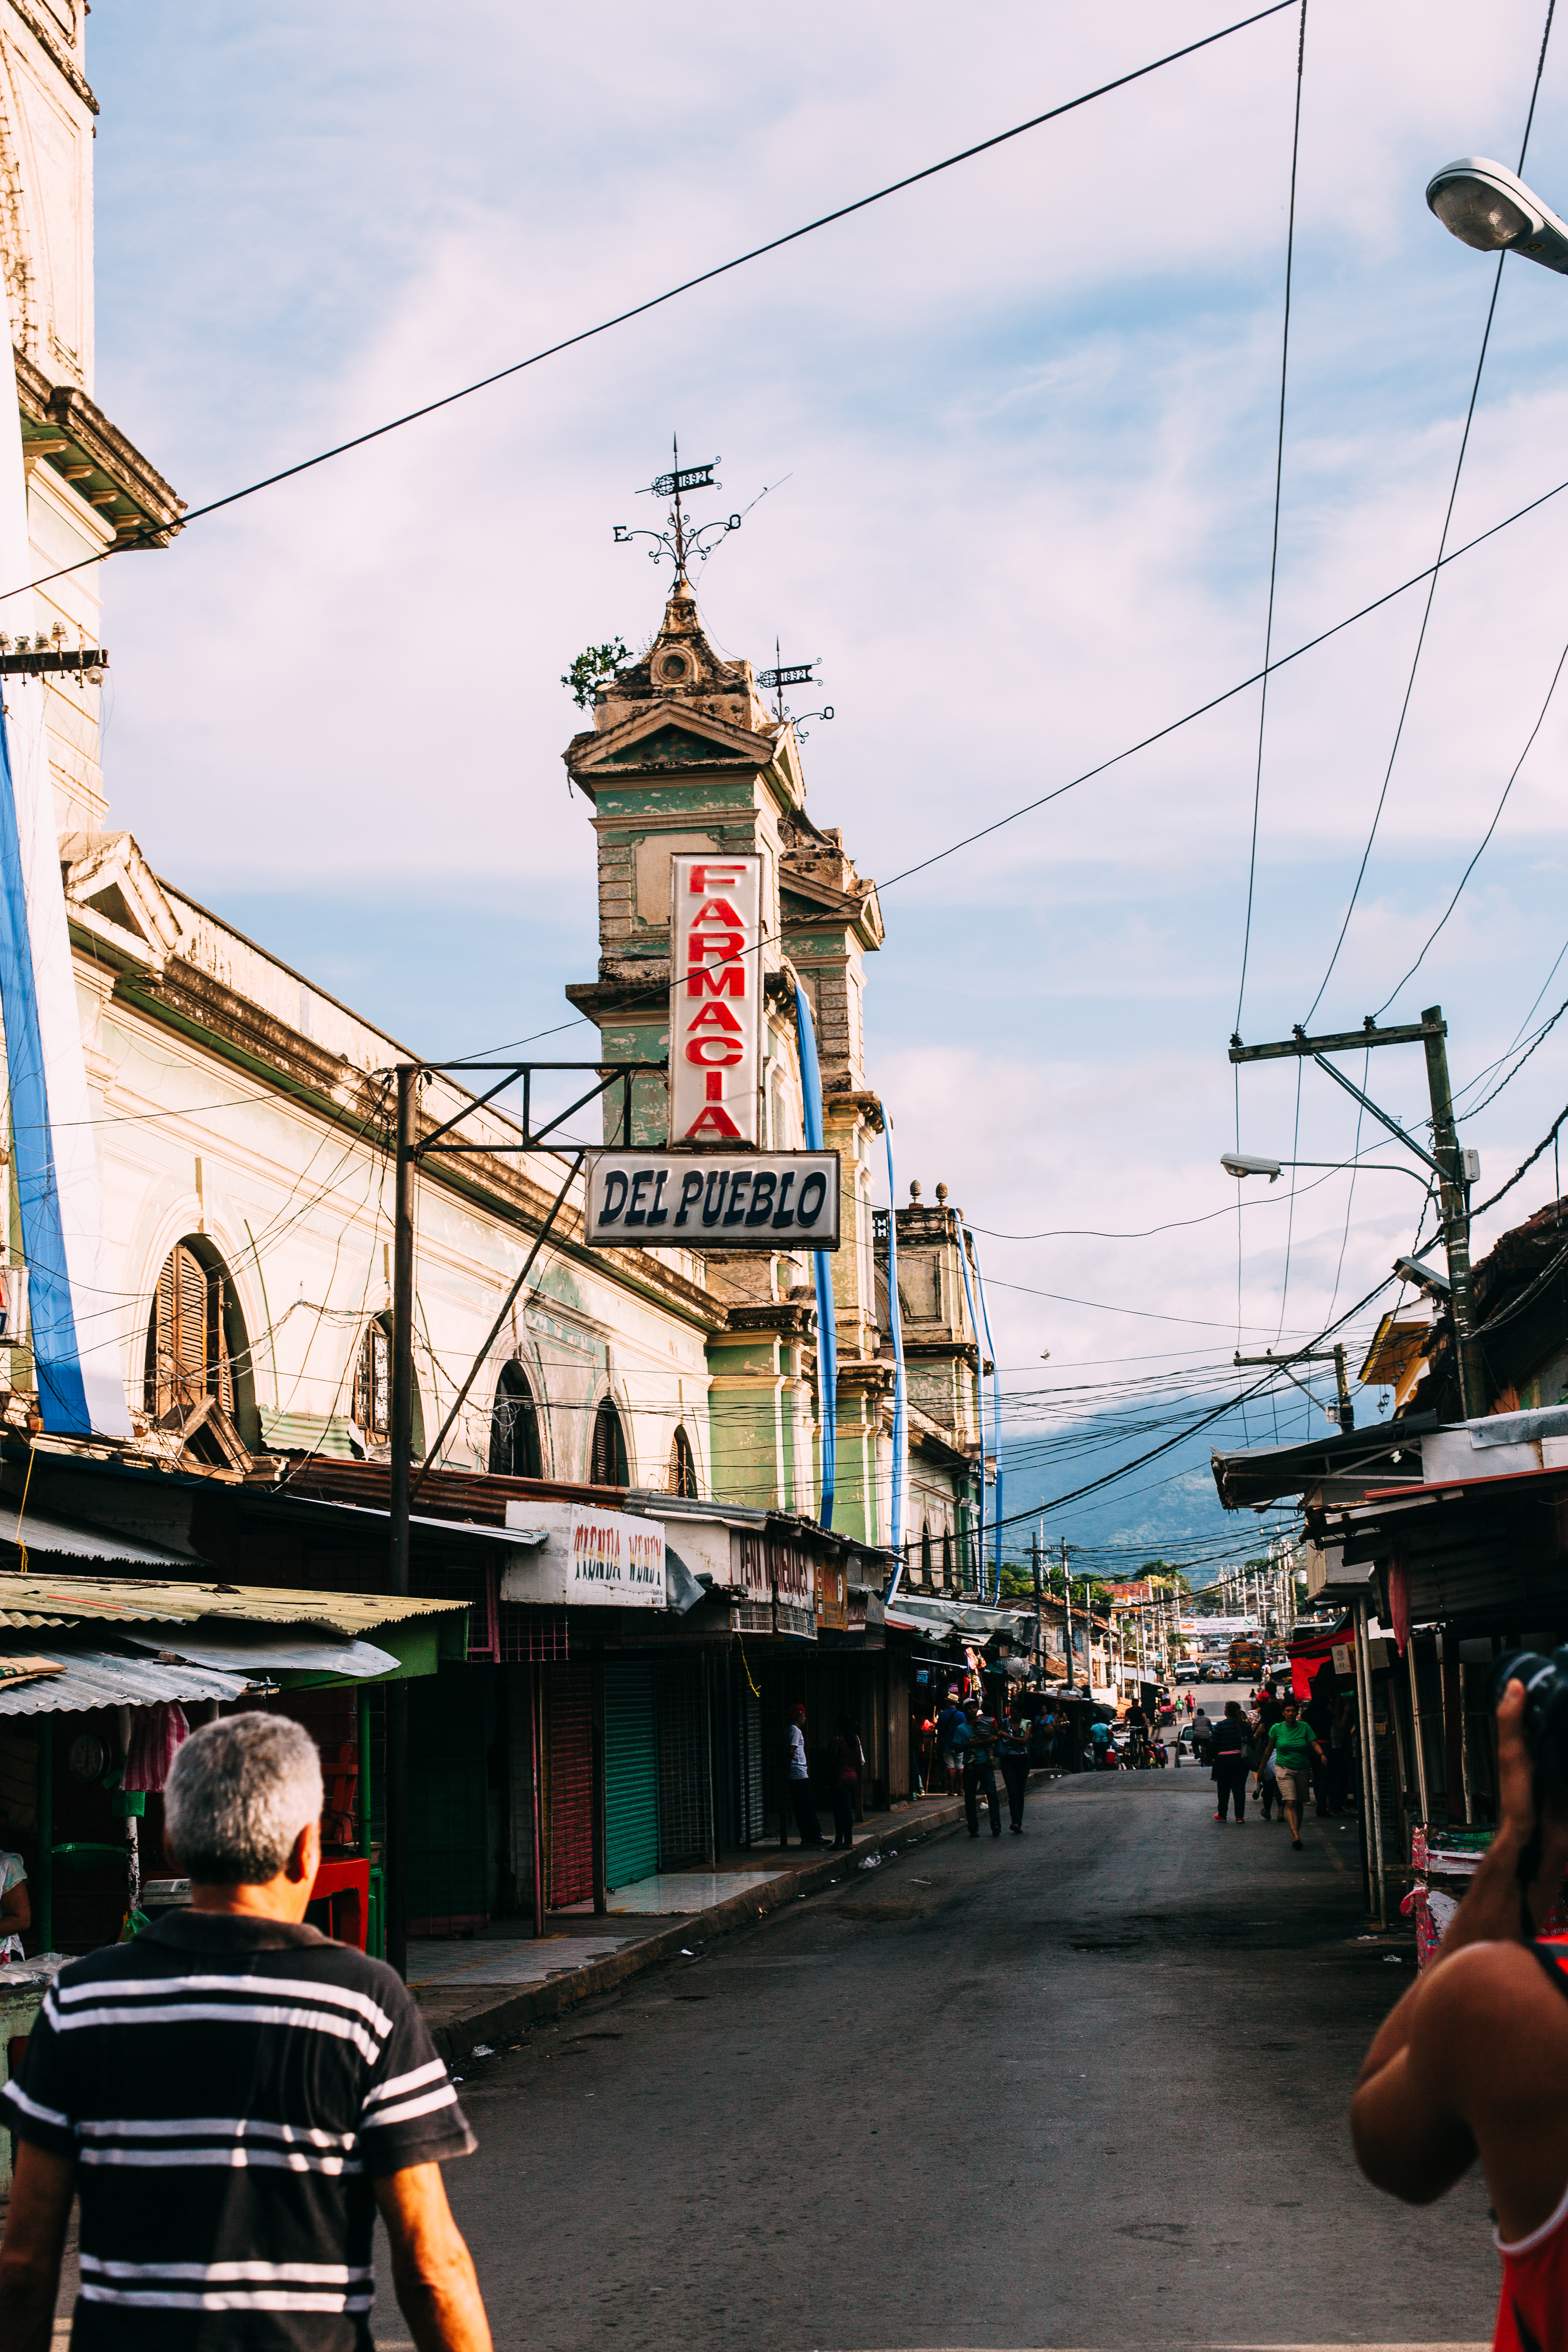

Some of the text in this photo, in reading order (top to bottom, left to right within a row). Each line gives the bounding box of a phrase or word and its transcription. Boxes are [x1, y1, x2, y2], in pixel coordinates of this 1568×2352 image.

[680, 471, 706, 487] 1892
[613, 526, 628, 542] E
[782, 669, 805, 682] 1892
[685, 864, 747, 1137] FARMACIA
[598, 1169, 827, 1226] DEL PUEBLO
[628, 1533, 662, 1587] WENDY
